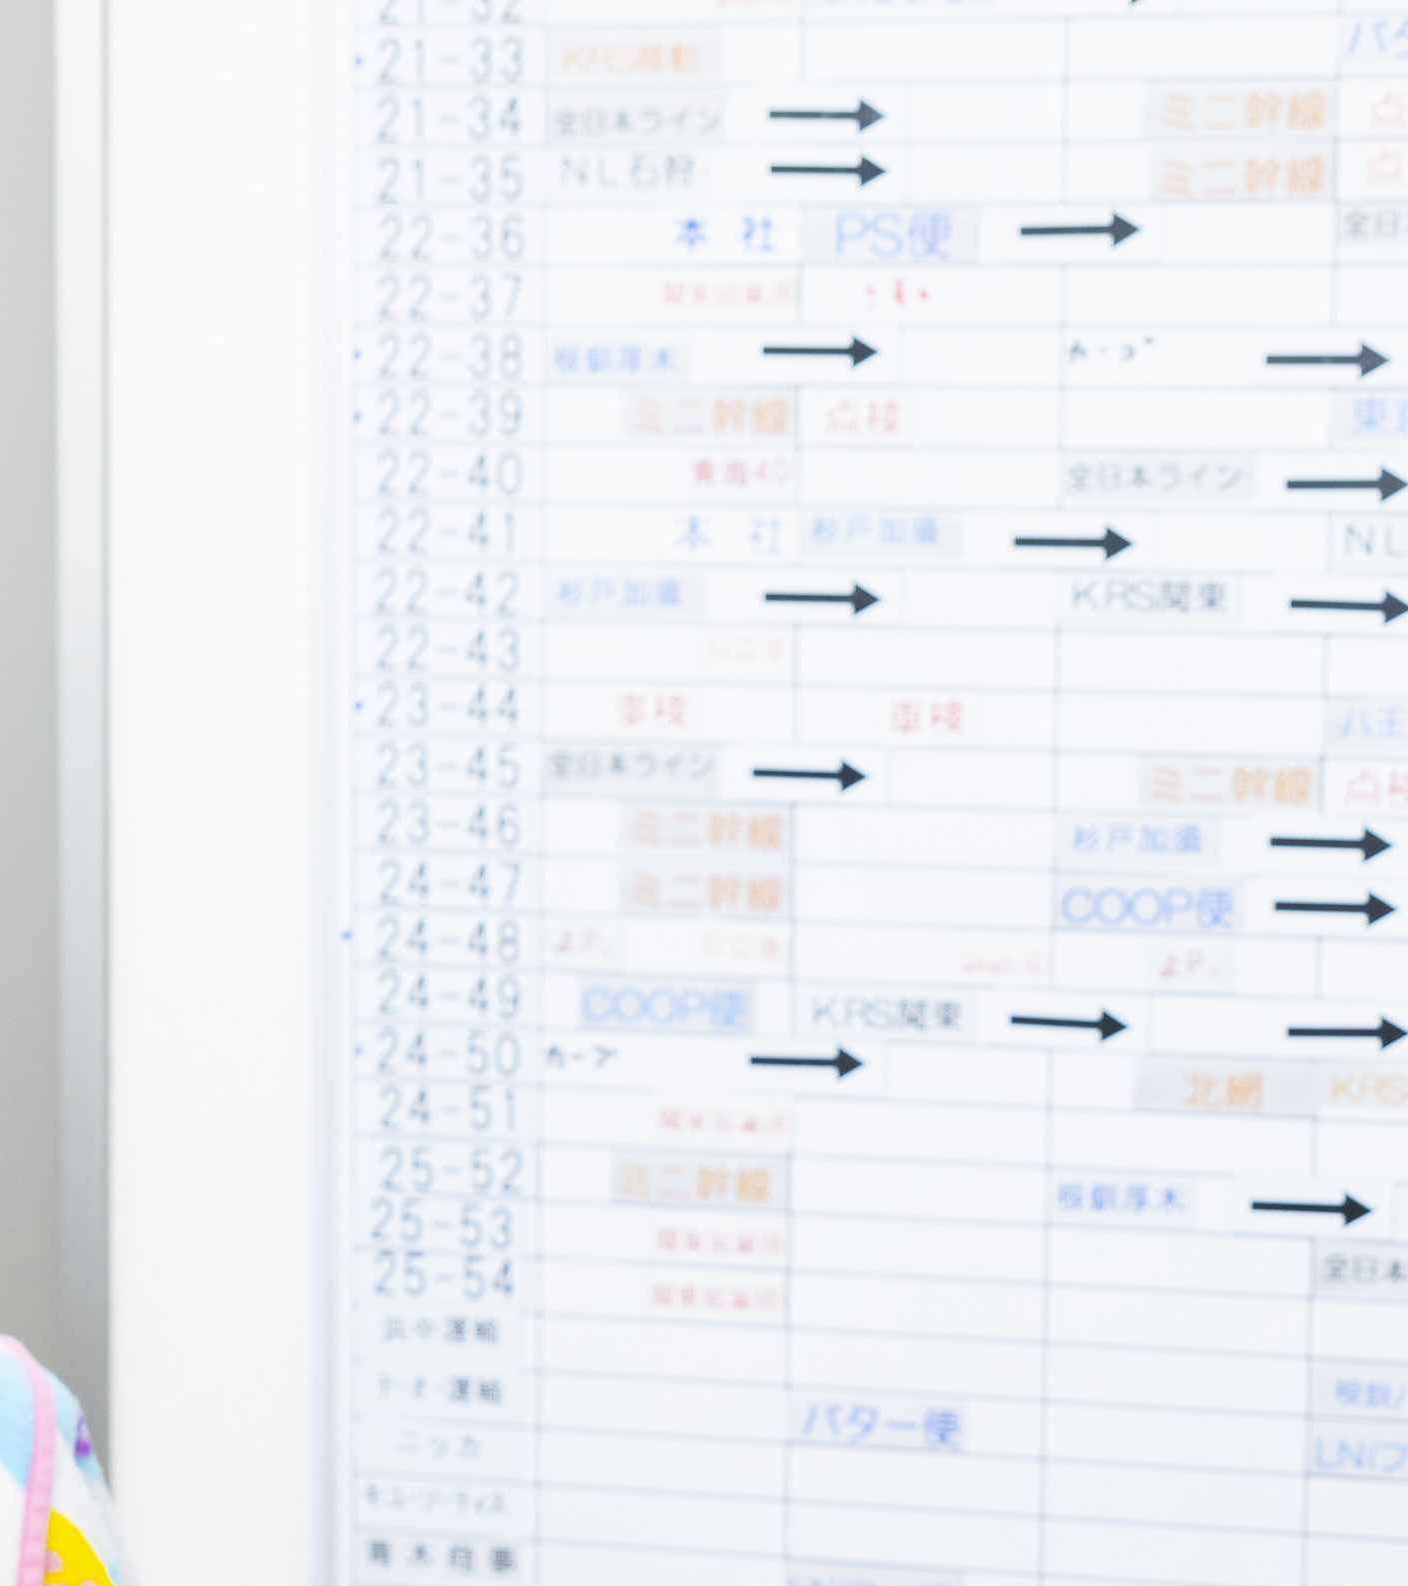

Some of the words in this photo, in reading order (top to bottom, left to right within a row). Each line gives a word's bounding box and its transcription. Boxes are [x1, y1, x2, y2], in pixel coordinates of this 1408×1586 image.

[377, 35, 525, 84] 21-33
[376, 94, 522, 143] 21-34
[554, 103, 723, 138] 全日本ライン
[1159, 90, 1327, 132] ミニ幹線
[376, 155, 524, 203] 21-35
[1159, 155, 1326, 197] ミニ幹線
[377, 212, 527, 260] 22-36
[834, 211, 953, 262] PS便
[377, 270, 524, 320] 22-37
[377, 332, 524, 378] 22-38
[377, 388, 525, 436] 22-39
[375, 448, 525, 495] 22-40
[1067, 462, 1243, 493] 全日本ライン
[375, 506, 518, 555] 22-41
[374, 566, 522, 615] 22-42
[1071, 578, 1228, 615] KRS関東
[374, 624, 522, 673] 22-43
[376, 682, 520, 727] 23-44
[376, 741, 522, 786] 23-45
[550, 751, 717, 782] 全日本ライン
[1150, 765, 1313, 804] ミニ幹線
[375, 800, 523, 845] 23-46
[376, 859, 522, 906] 24-47
[1061, 885, 1234, 929] COOP便
[375, 916, 522, 961] 24-48
[375, 974, 521, 1019] 24-49
[580, 985, 746, 1031] COOP便
[375, 1033, 522, 1078] 24-50
[377, 1086, 518, 1131] 24-51
[379, 1146, 523, 1194] 25-52
[369, 1198, 514, 1250] 25-53
[372, 1253, 514, 1301] 25-54
